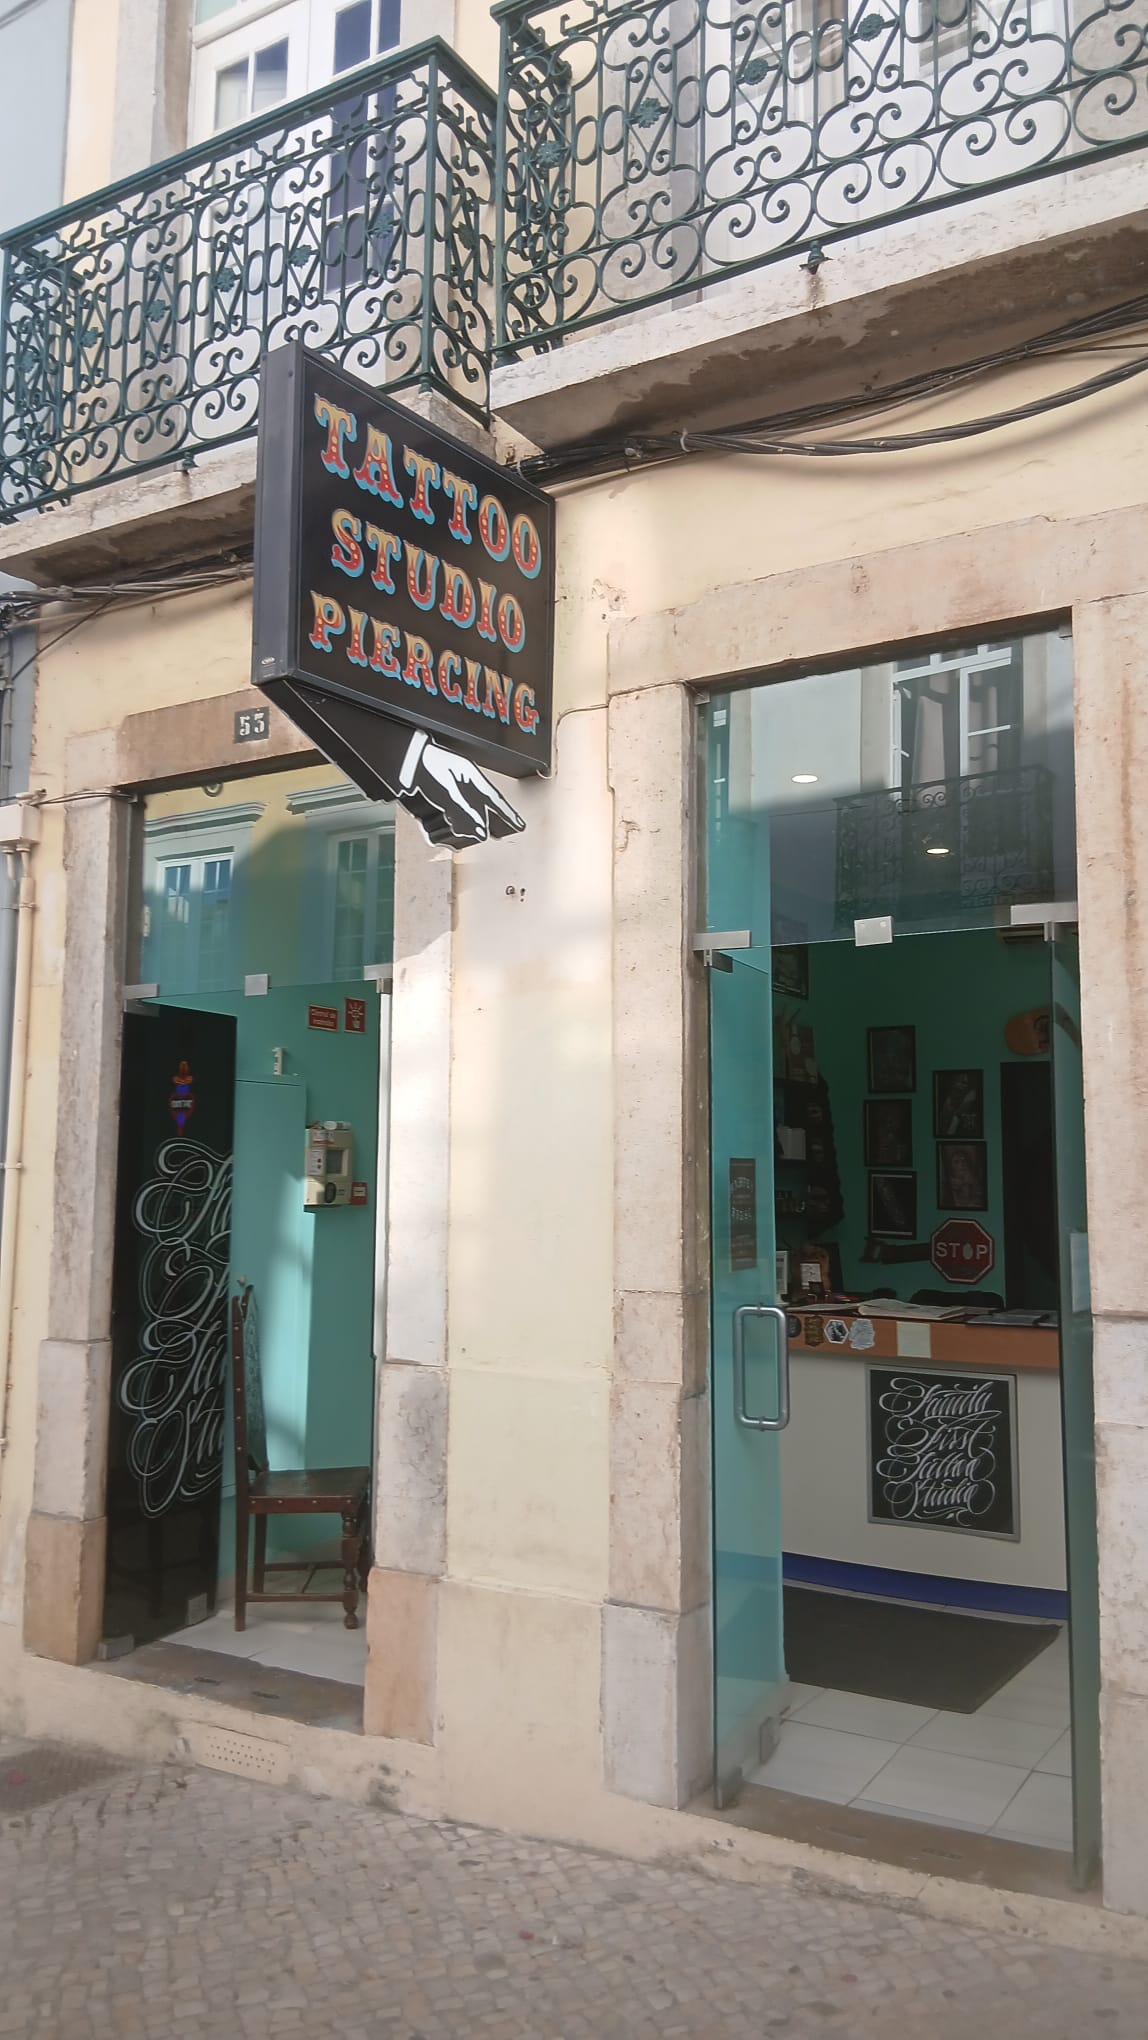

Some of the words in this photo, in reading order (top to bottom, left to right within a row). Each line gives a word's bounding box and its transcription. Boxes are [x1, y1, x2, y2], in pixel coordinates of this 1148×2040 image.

[314, 393, 542, 580] TATTOO
[331, 508, 526, 653] STUDIO
[308, 591, 540, 735] PIERCING
[935, 1241, 989, 1260] STOP
